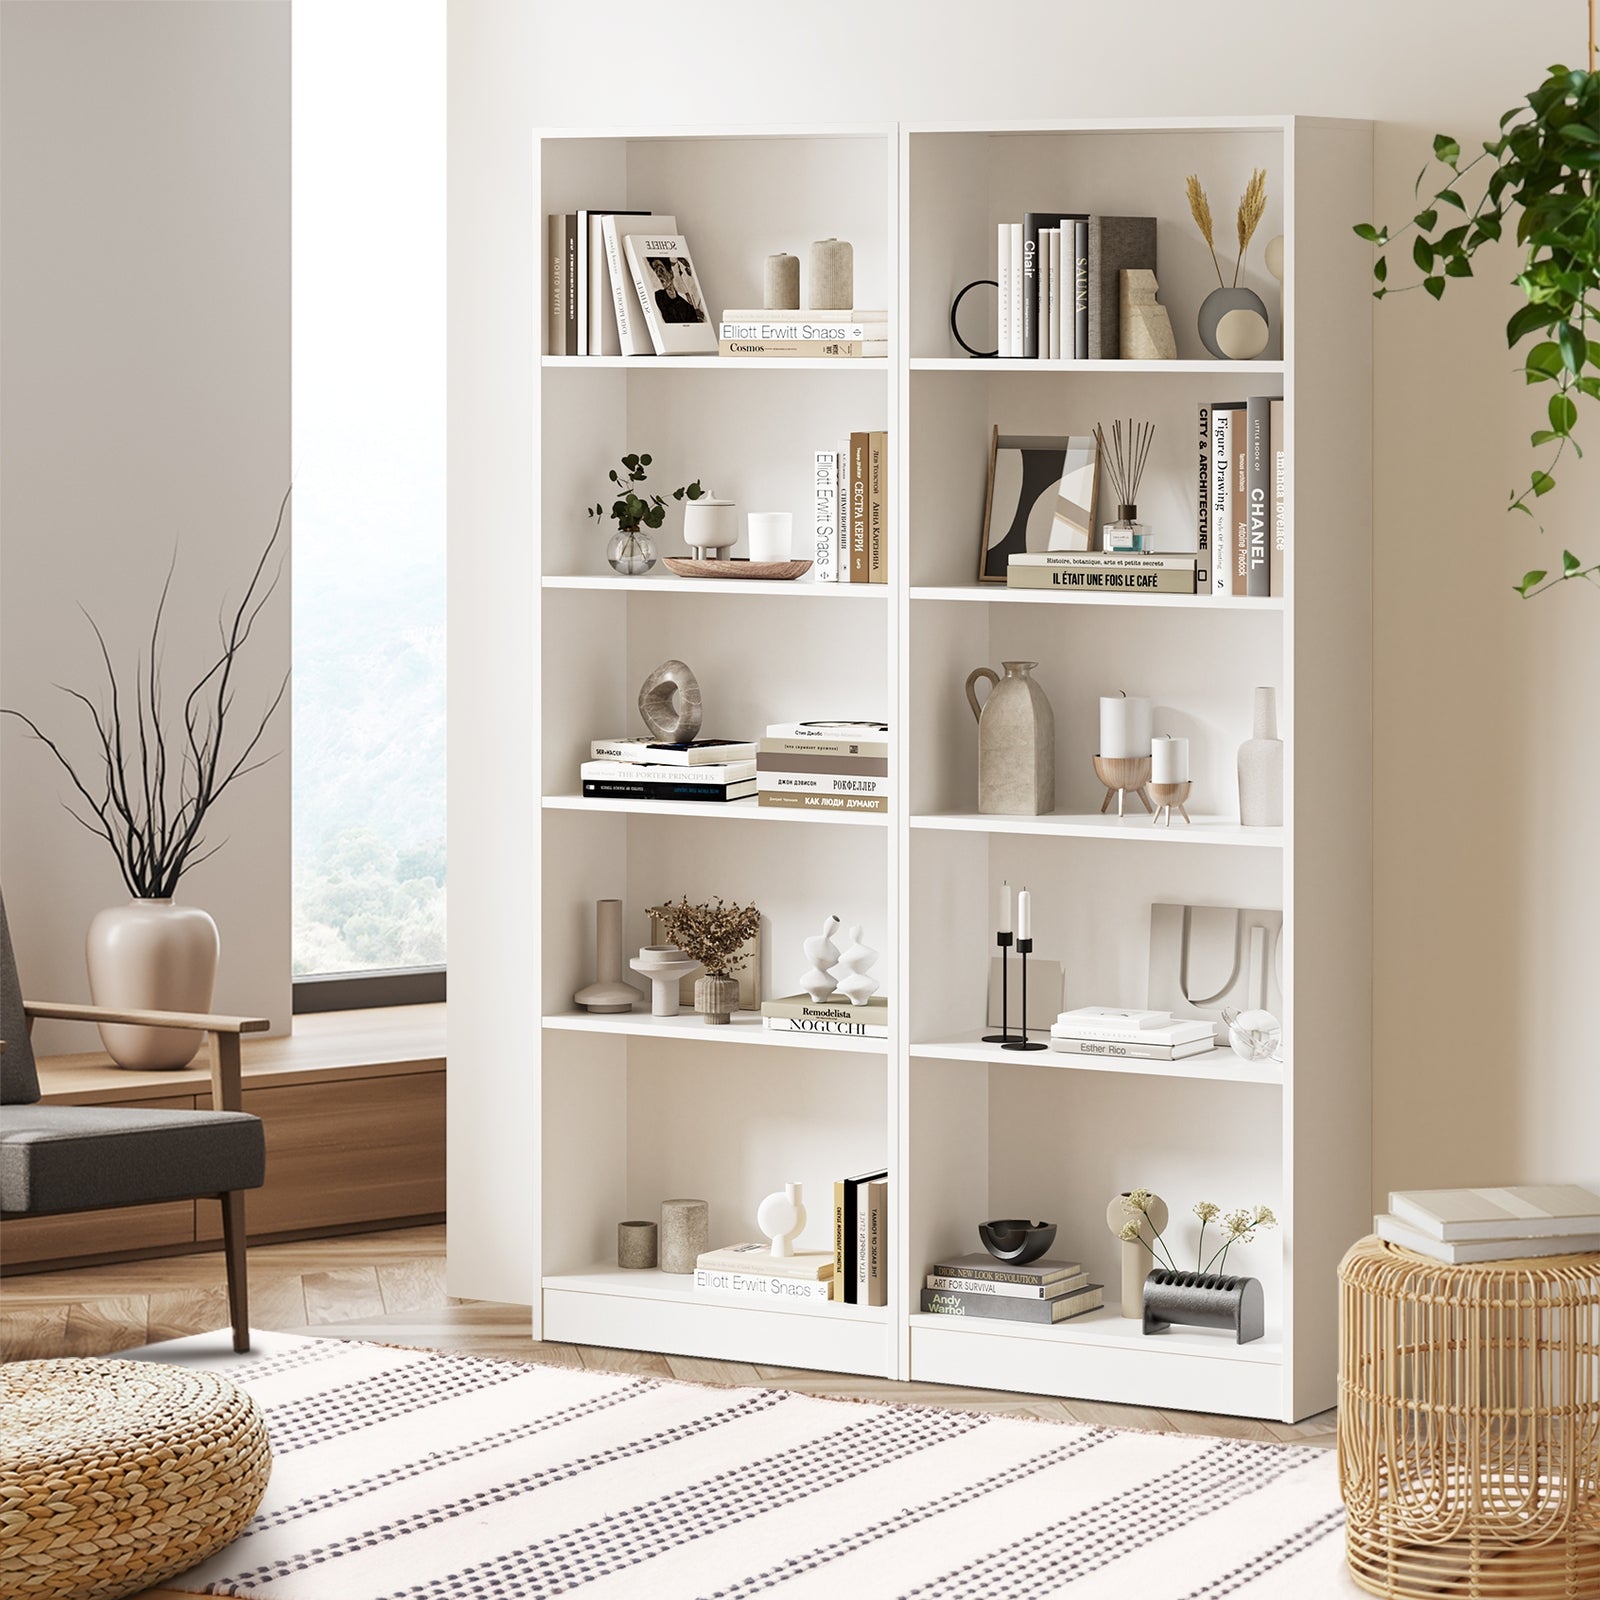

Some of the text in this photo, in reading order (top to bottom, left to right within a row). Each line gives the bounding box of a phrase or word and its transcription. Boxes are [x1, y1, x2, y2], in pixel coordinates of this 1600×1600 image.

[1024, 240, 1036, 278] Chair
[1076, 257, 1087, 313] SAUNA
[723, 324, 757, 339] Elliott
[761, 324, 798, 339] Erwitt
[730, 343, 764, 352] Cosmos
[816, 454, 833, 485] Elliott
[1214, 417, 1228, 512] Figure Drawing
[1199, 408, 1208, 550] CITY & ARCHITECTURE
[816, 490, 833, 522] Erwitt
[854, 481, 864, 552] СЕСТРА КЕРРИ
[1251, 488, 1264, 570] CHANEL
[1238, 522, 1247, 577] Antoine Predock
[1047, 557, 1071, 565] Histoire,
[1073, 558, 1103, 566] botanique,
[1053, 571, 1157, 587] IL ÉTAIT UNE FOIS LE CAFÉ
[636, 771, 667, 780] PORTER
[668, 772, 715, 781] PRINCIPLES
[833, 780, 877, 792] РОКФЕЛЛЕР
[804, 797, 820, 806] КАК
[820, 798, 844, 807] ЛЮДИ
[846, 799, 880, 809] ДУМАЮТ
[802, 1007, 851, 1019] Remodelista
[790, 1018, 866, 1035] NOGUCHI
[1080, 1042, 1106, 1054] Esther
[1108, 1045, 1127, 1056] Rico
[697, 1271, 729, 1288] Elliott
[733, 1275, 767, 1292] Erwitt
[957, 1269, 974, 1278] NEW
[974, 1271, 994, 1280] LOOK
[994, 1273, 1038, 1284] REVOLUTION
[933, 1279, 997, 1293] ART FOR SURVIVAL
[933, 1294, 961, 1307] Andy
[928, 1303, 966, 1315] Warhol
